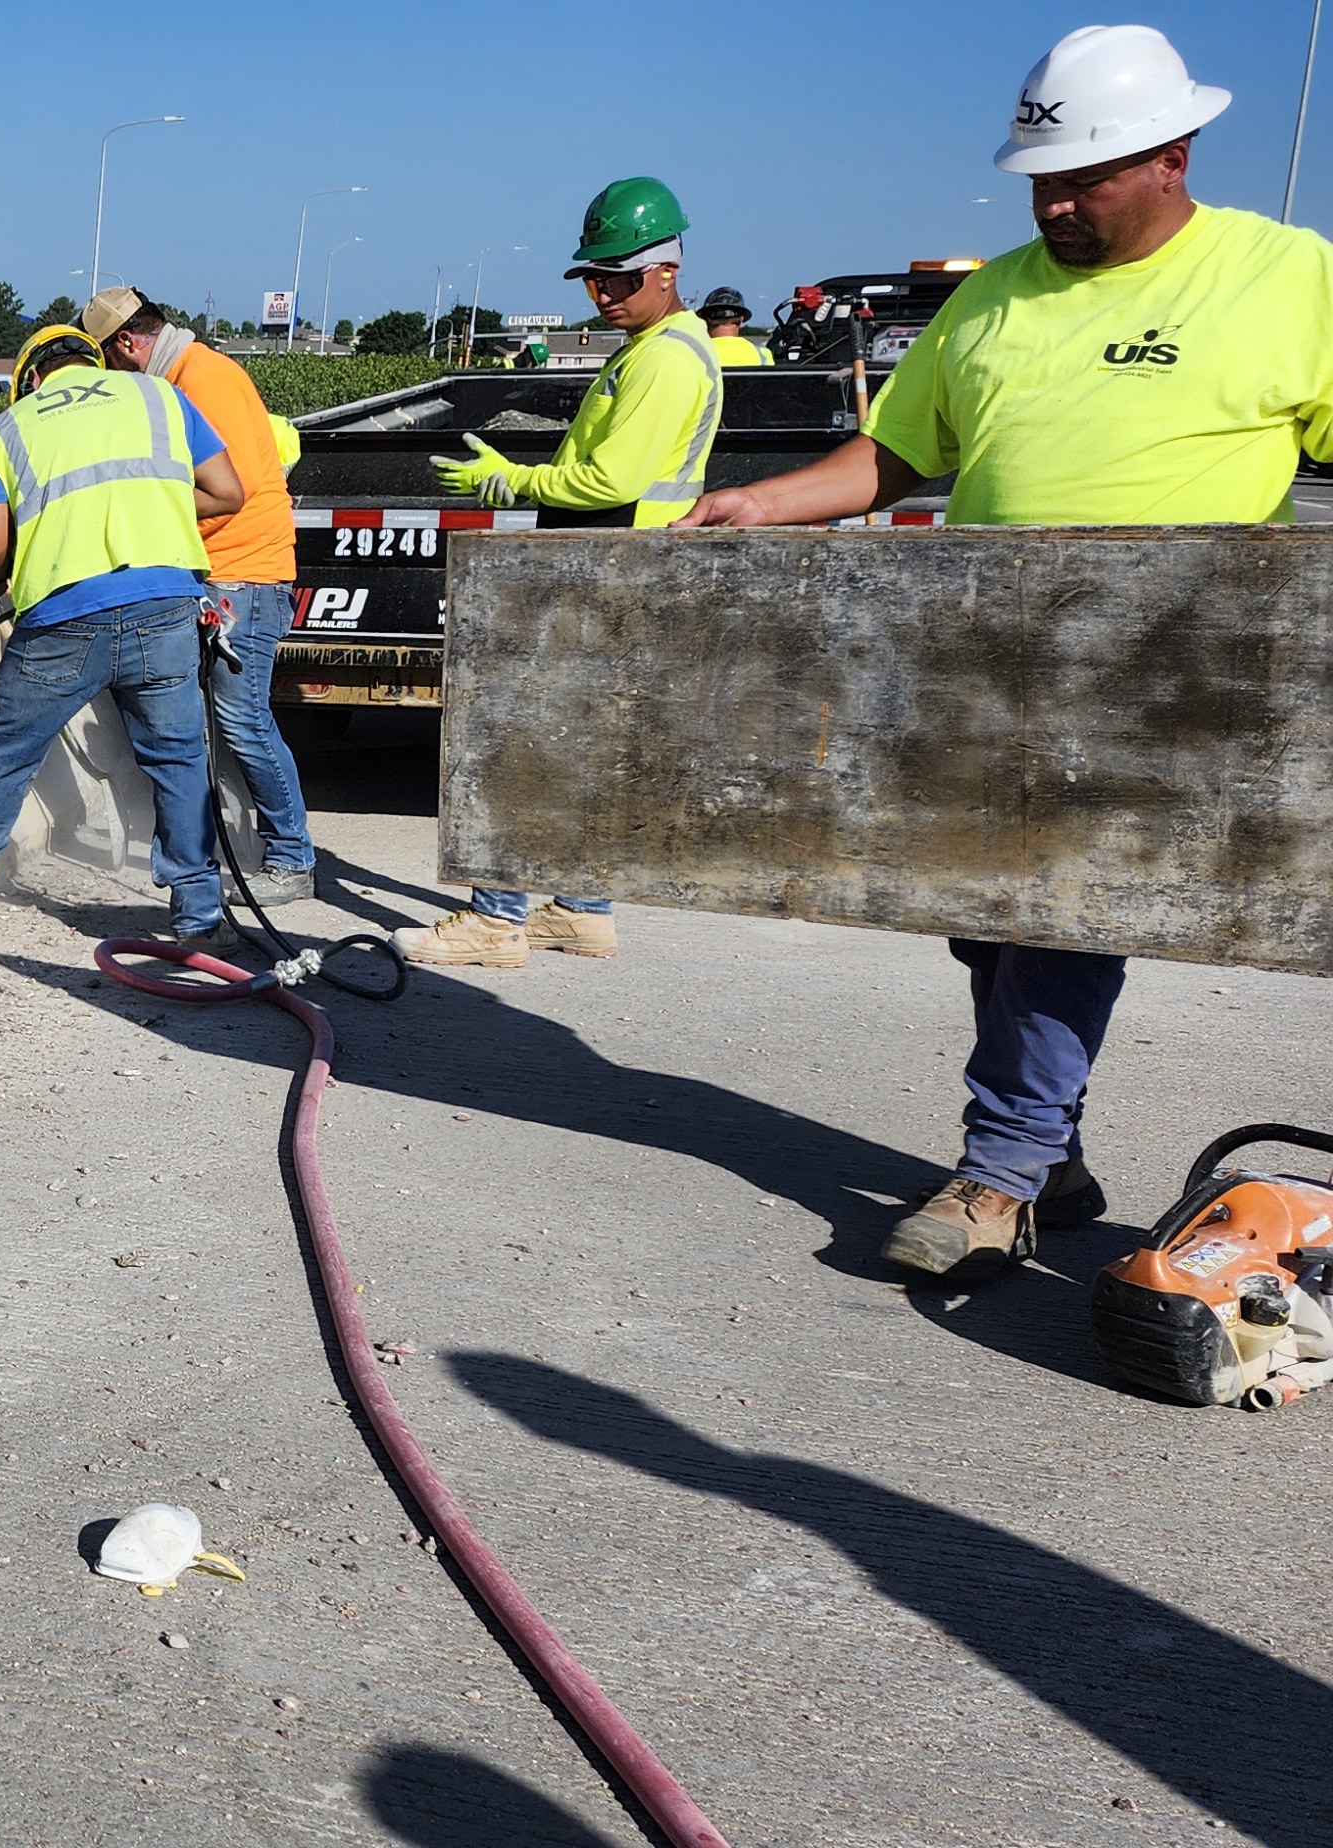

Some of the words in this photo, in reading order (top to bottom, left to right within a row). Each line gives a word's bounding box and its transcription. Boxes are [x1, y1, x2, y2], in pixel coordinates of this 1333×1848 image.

[510, 315, 563, 326] RESTAURANT
[40, 411, 56, 422] civil
[66, 397, 120, 412] construction
[334, 528, 437, 557] 29248
[308, 588, 369, 619] PJ
[306, 620, 358, 629] TRAILERS
